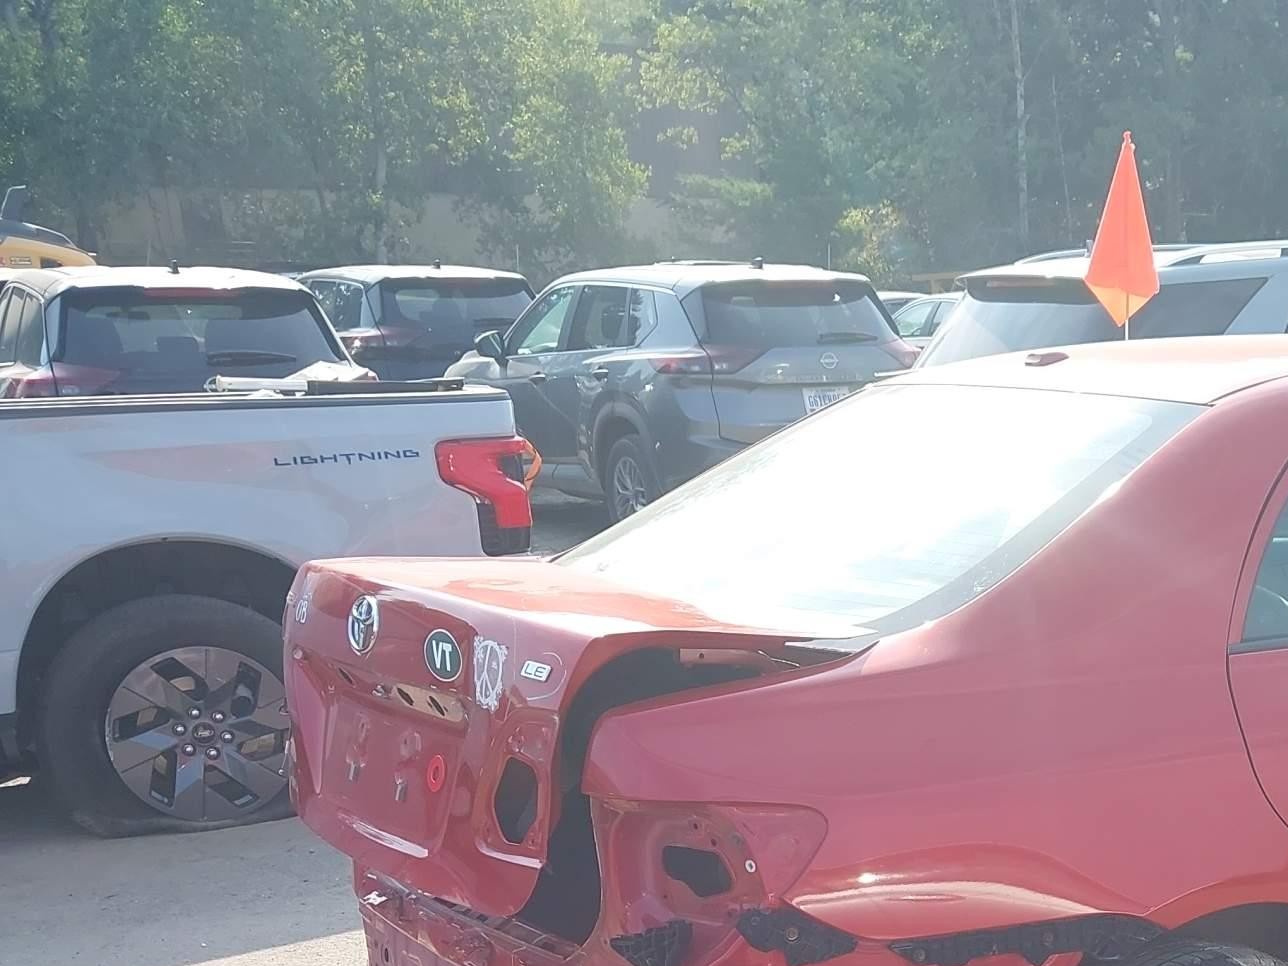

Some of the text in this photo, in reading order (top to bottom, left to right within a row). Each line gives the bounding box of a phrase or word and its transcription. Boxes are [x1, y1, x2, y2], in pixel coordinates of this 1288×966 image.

[274, 449, 420, 466] LIGHTNING
[432, 639, 452, 672] VT
[524, 663, 547, 679] LE
